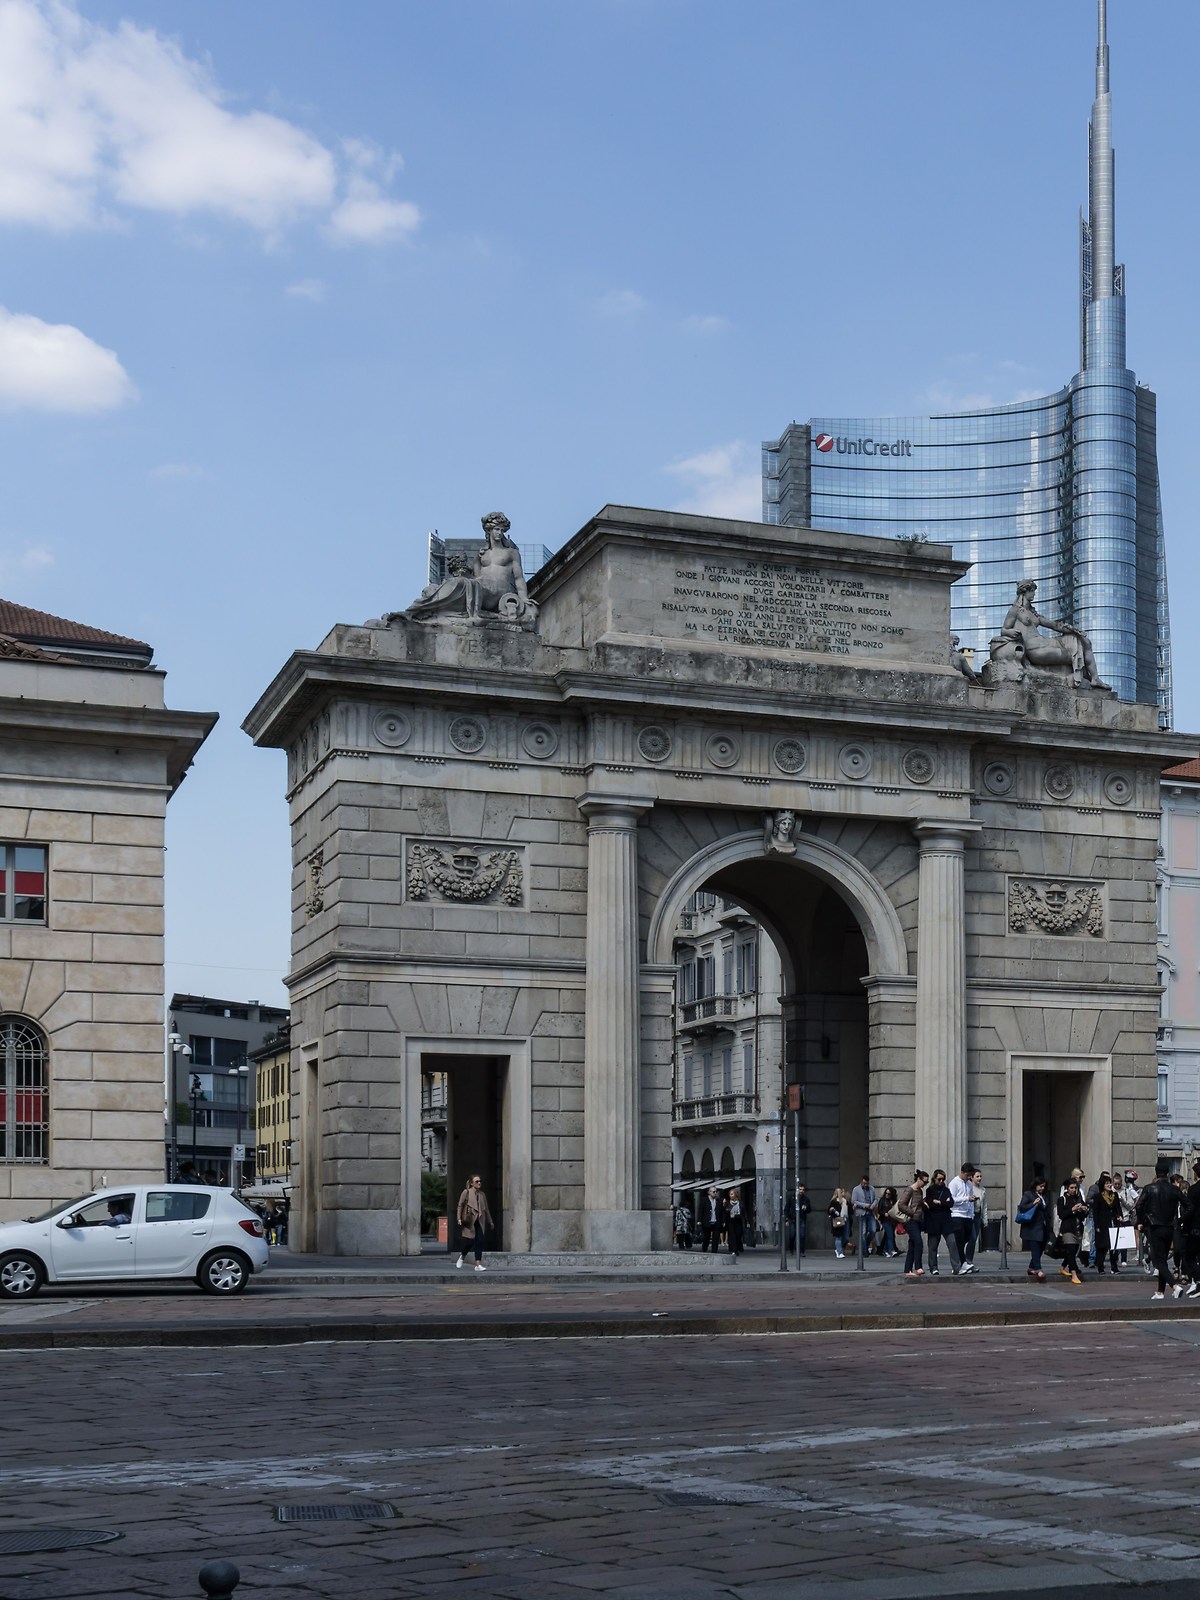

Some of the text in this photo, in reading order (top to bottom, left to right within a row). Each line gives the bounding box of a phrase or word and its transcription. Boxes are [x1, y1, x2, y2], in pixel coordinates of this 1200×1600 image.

[836, 437, 911, 456] UniCredit
[704, 566, 727, 574] FATTE
[800, 576, 824, 584] DELLE
[827, 579, 864, 589] VITTORIE
[796, 567, 820, 576] PORTE
[676, 571, 697, 579] ONDE
[709, 575, 739, 584] GIOVANI
[744, 579, 775, 588] ACCORSI
[840, 590, 889, 600] COMBATTERE
[777, 591, 816, 600] GARIBALDI
[712, 608, 733, 616] DOPO
[738, 611, 751, 619] XXI
[756, 613, 774, 621] ANNI
[743, 595, 758, 603] NEL
[762, 597, 802, 607] MDCCCLIX
[820, 604, 854, 613] SECONDA
[858, 607, 892, 617] RISCOSSA
[754, 605, 786, 614] POPOLO
[790, 609, 827, 618] MILANESE
[718, 626, 748, 636] ETERNA
[835, 638, 850, 646] NEL
[853, 640, 883, 648] BRONZO
[733, 636, 790, 648] RICONOSCENZA
[795, 642, 819, 650] DELLA
[823, 646, 850, 654] PATRIA
